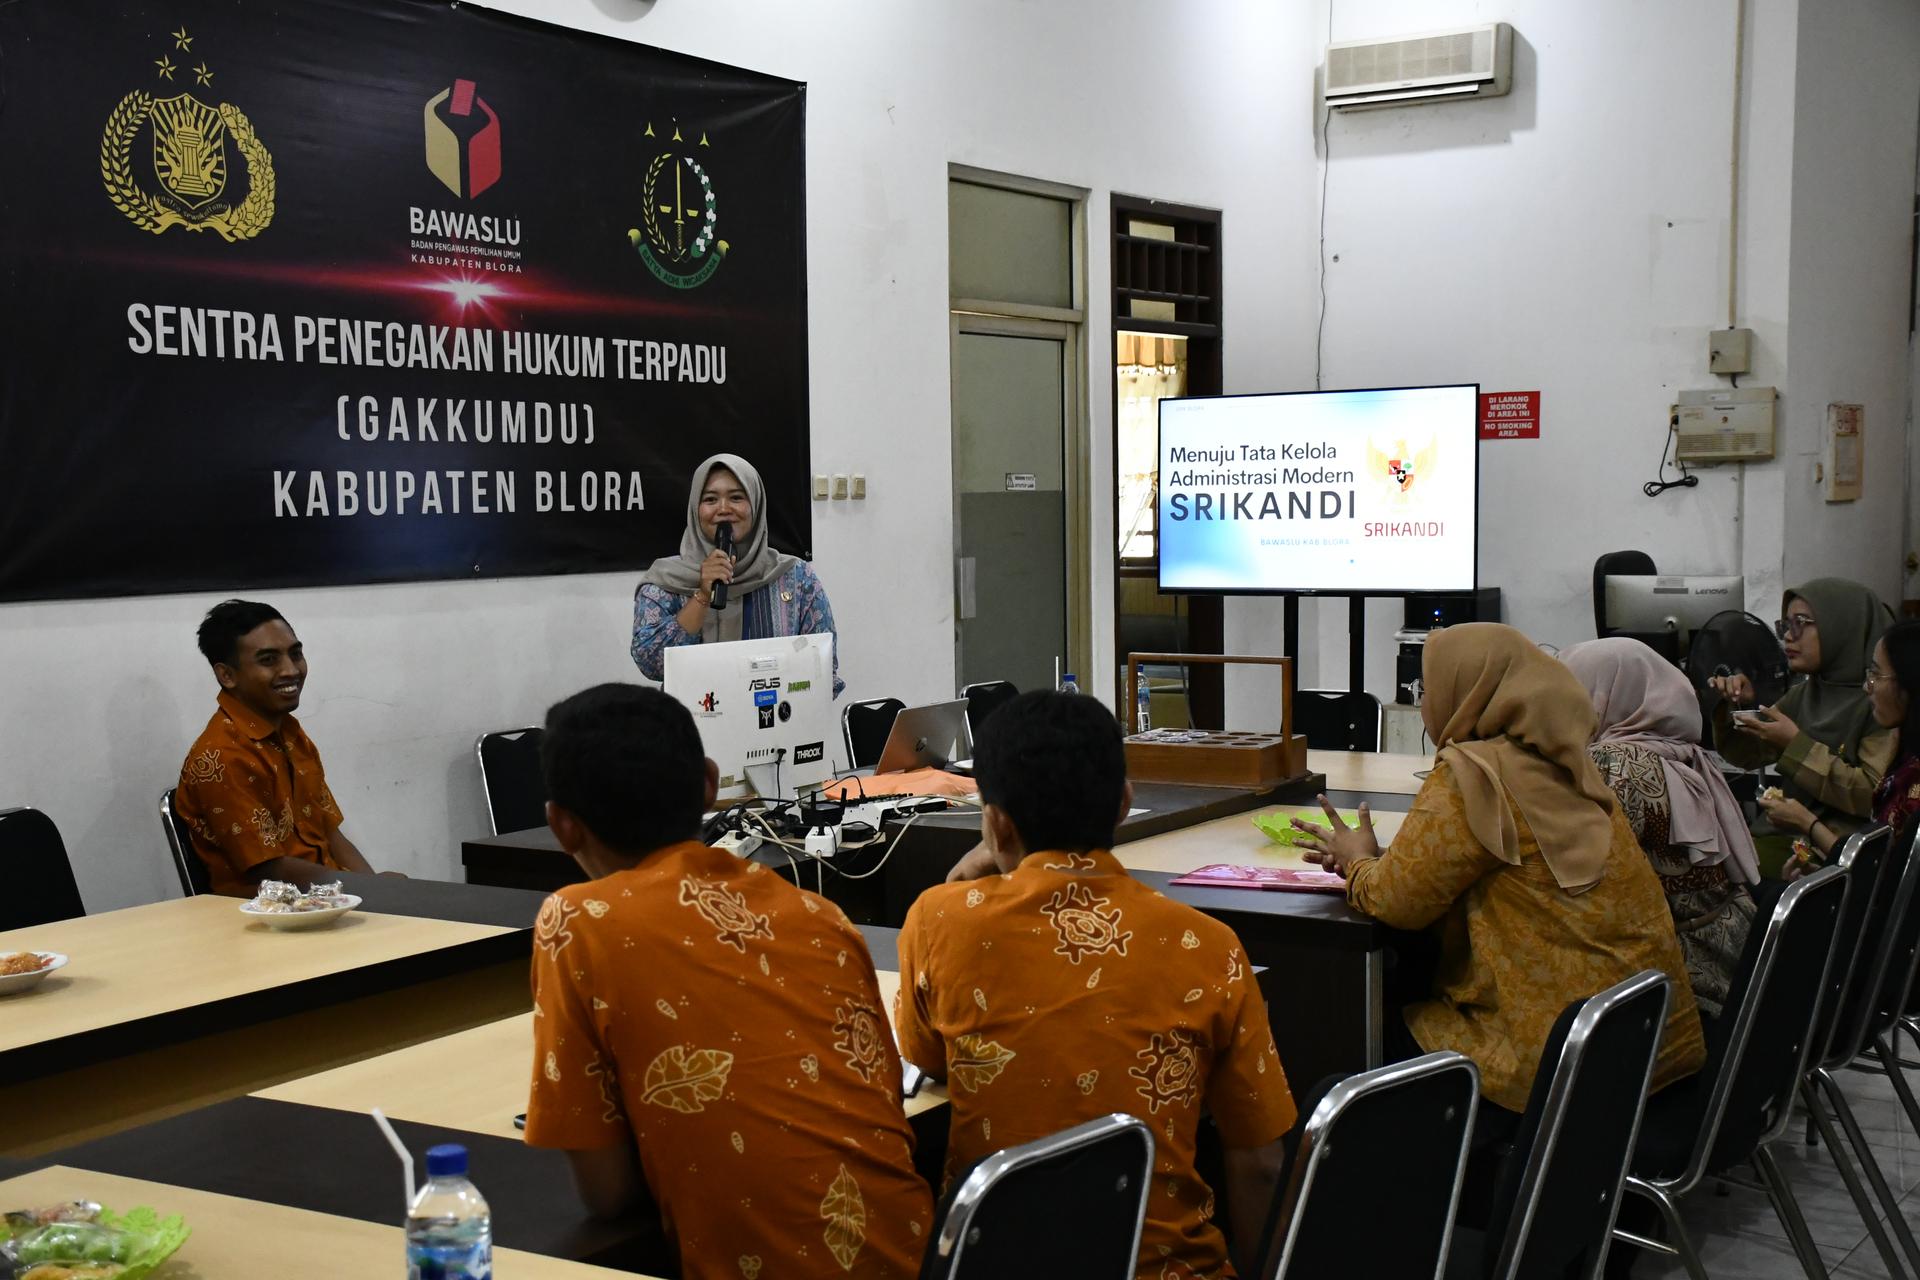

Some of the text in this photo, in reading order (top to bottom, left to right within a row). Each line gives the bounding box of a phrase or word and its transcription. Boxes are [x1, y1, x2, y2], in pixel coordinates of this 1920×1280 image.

[409, 206, 521, 246] BAWASLU
[411, 240, 521, 259] BADAN PENGAWAS PEMILIHAN UMUM
[411, 254, 522, 273] KABUPATEN BLORA
[127, 302, 727, 385] SENTRA PENEGAKAN HUKUM TERPADU
[337, 395, 595, 445] (GAKKUMDU)
[1498, 422, 1533, 430] SMOKING
[1170, 442, 1337, 464] Menuju Tata Kelola
[1170, 466, 1354, 487] Administrasi Modern
[273, 470, 645, 518] KABUPATEN BLORA
[1170, 490, 1355, 521] SRIKANDI
[1364, 522, 1444, 537] SRIKANDI
[749, 677, 781, 692] ASUS
